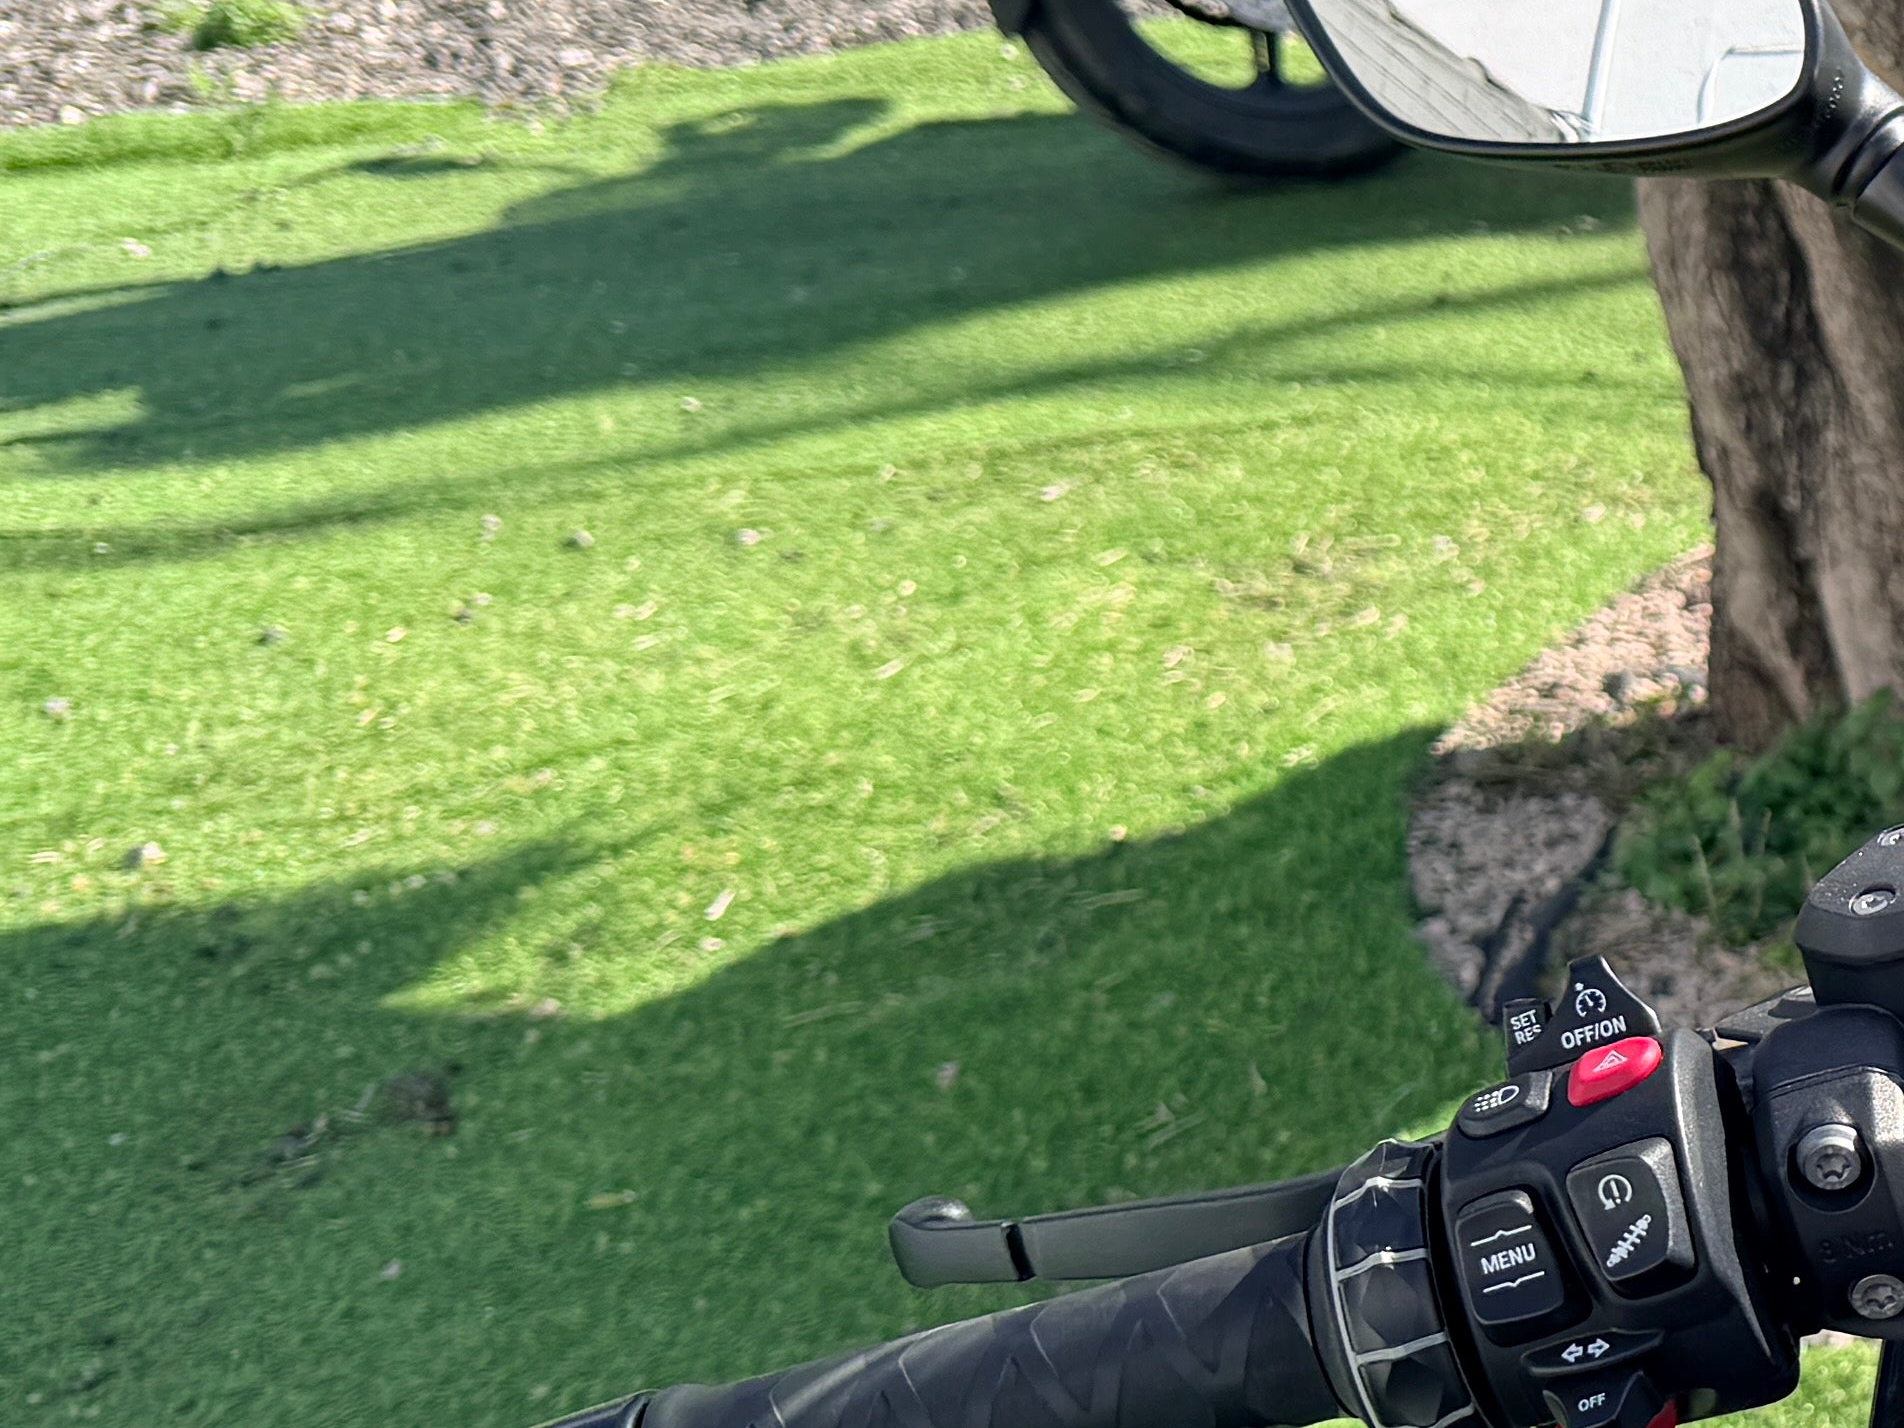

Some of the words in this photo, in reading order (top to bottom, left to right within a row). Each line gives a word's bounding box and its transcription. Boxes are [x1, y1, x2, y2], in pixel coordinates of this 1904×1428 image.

[1510, 1009, 1537, 1030] SET
[1514, 1024, 1542, 1045] RES
[1561, 1015, 1627, 1049] OFF/ON
[1481, 1243, 1536, 1274] MENU
[1578, 1393, 1606, 1412] OFF
